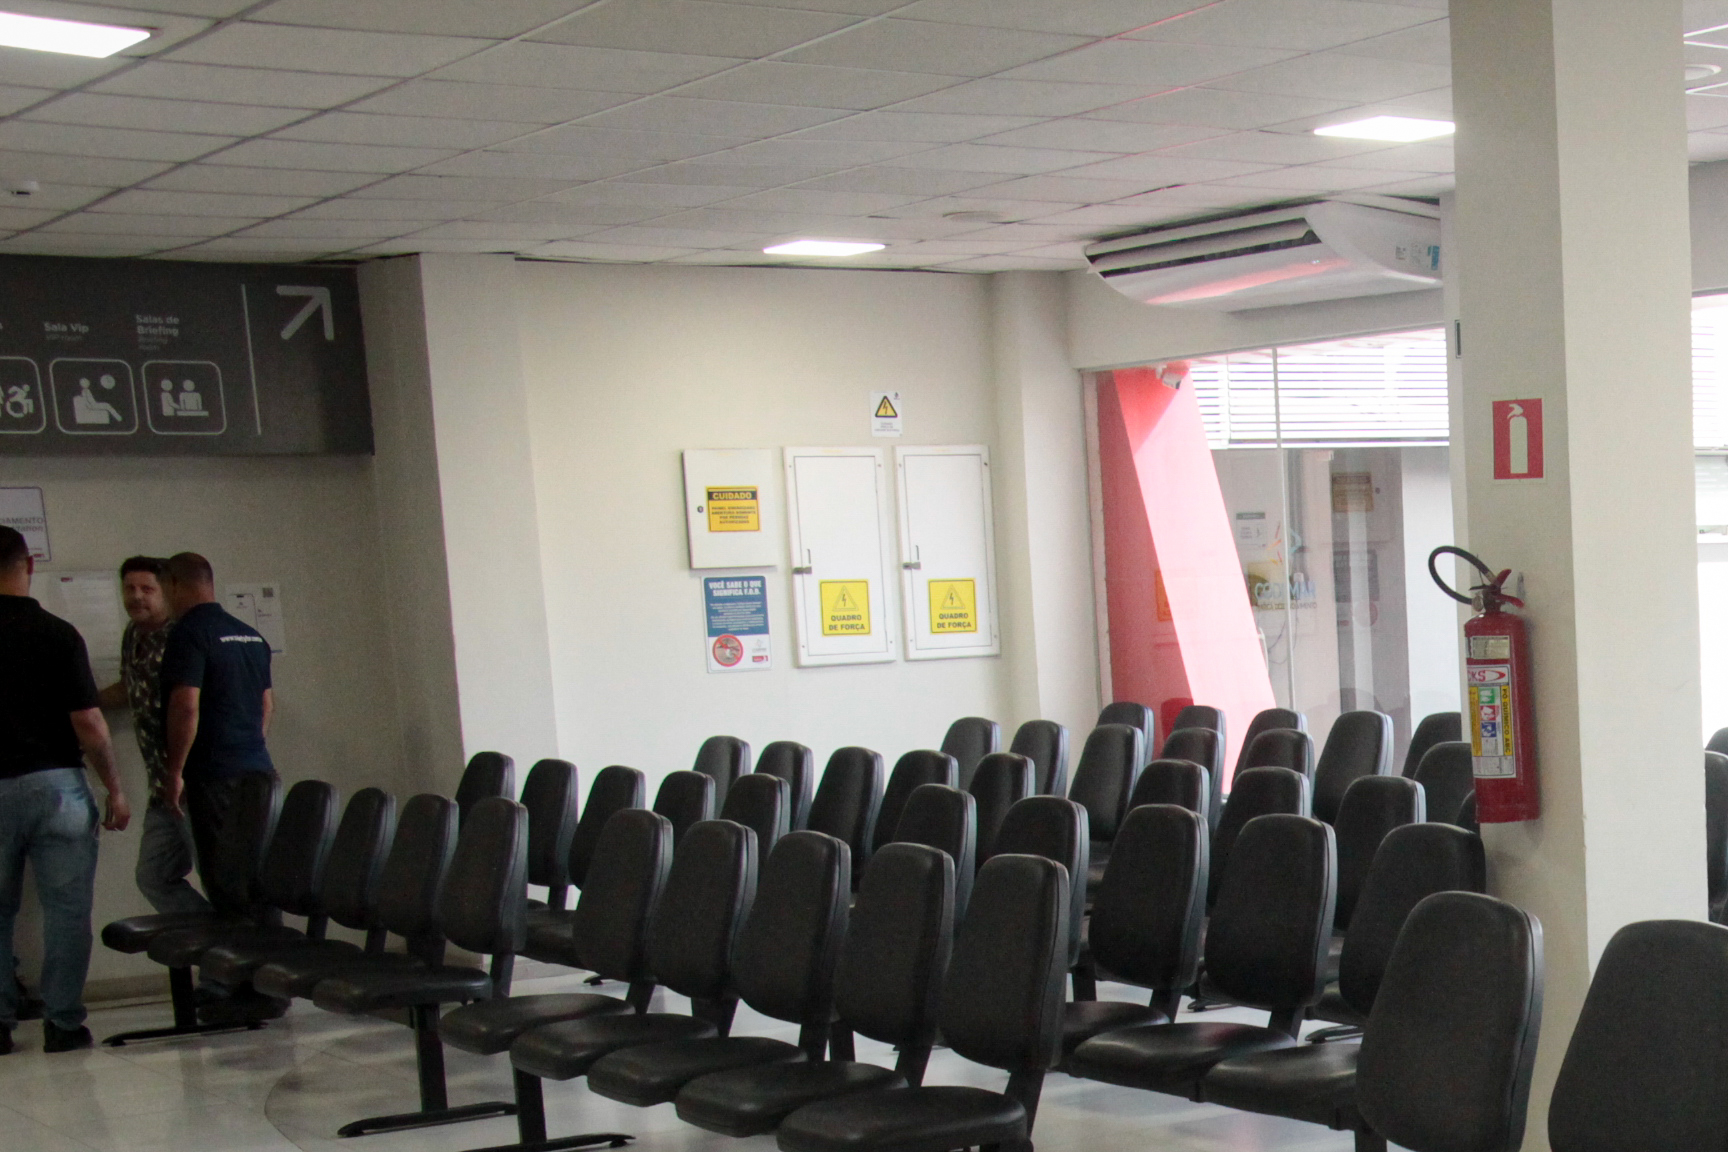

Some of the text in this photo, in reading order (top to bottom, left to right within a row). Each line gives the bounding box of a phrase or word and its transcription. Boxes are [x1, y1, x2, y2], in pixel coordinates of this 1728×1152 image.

[136, 314, 180, 324] Salas de
[44, 321, 89, 335] Sala Vip
[137, 325, 180, 338] Briefing
[713, 492, 753, 500] CUIDADO
[708, 580, 725, 590] VOCÊ
[726, 581, 742, 589] SABE
[750, 580, 762, 588] QUE
[712, 588, 744, 597] SIGNIFICA
[830, 614, 862, 622] QUADRO
[938, 612, 969, 620] QUADRO
[840, 624, 865, 632] FORÇA
[947, 621, 972, 629] FORÇA
